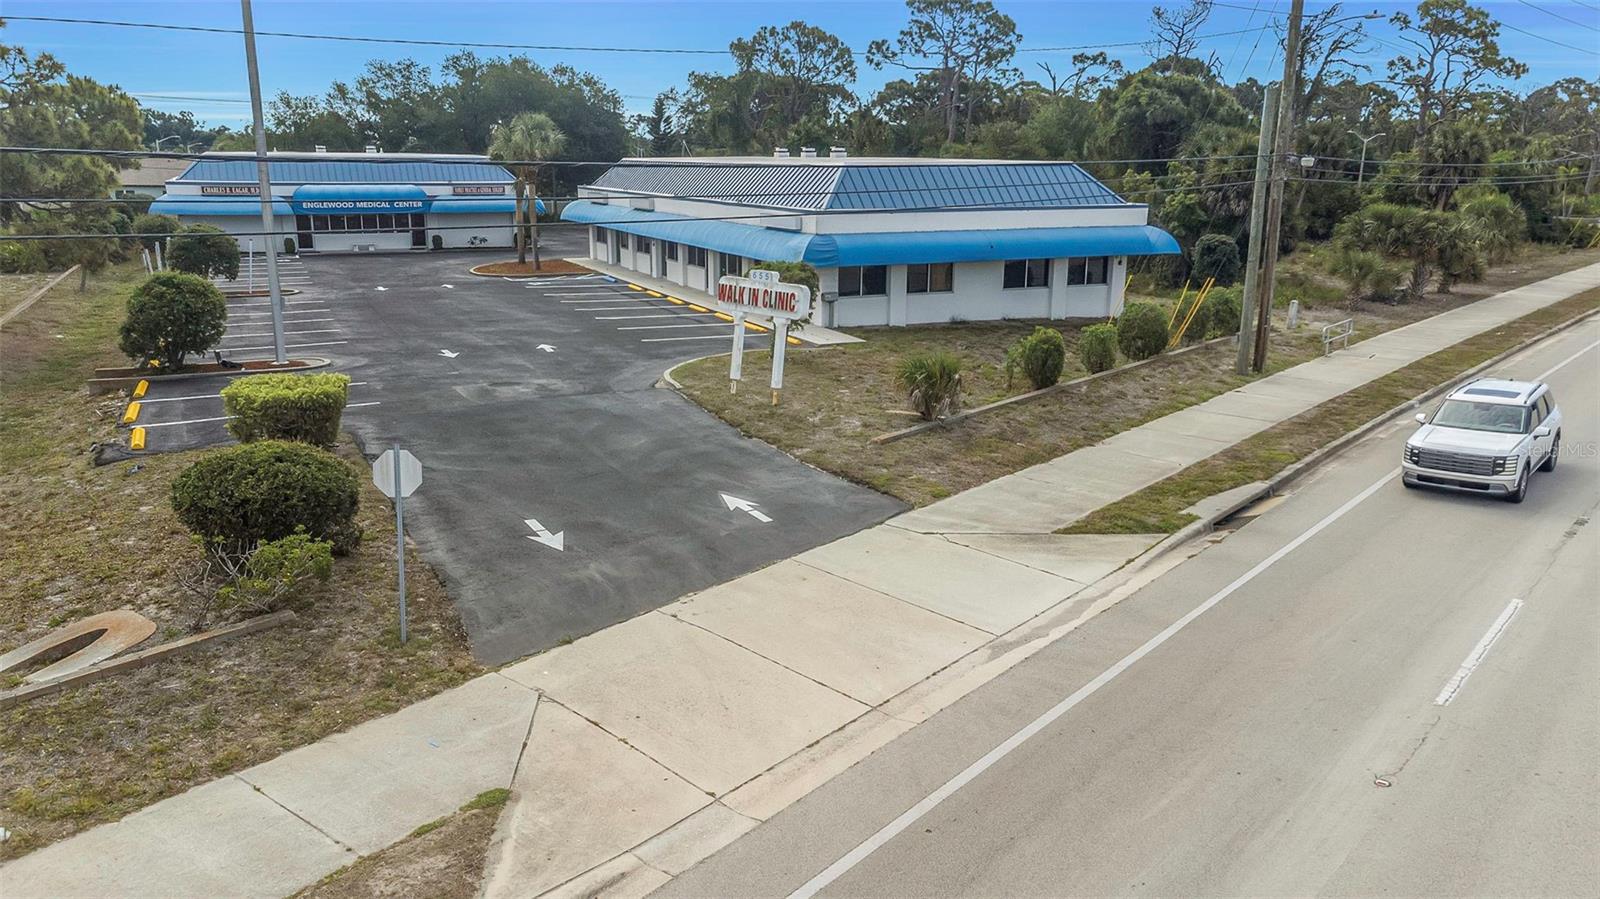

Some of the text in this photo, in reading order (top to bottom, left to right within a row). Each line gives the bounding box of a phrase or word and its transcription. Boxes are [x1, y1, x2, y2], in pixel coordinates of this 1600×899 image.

[718, 283, 797, 313] WALK IN CLINIC
